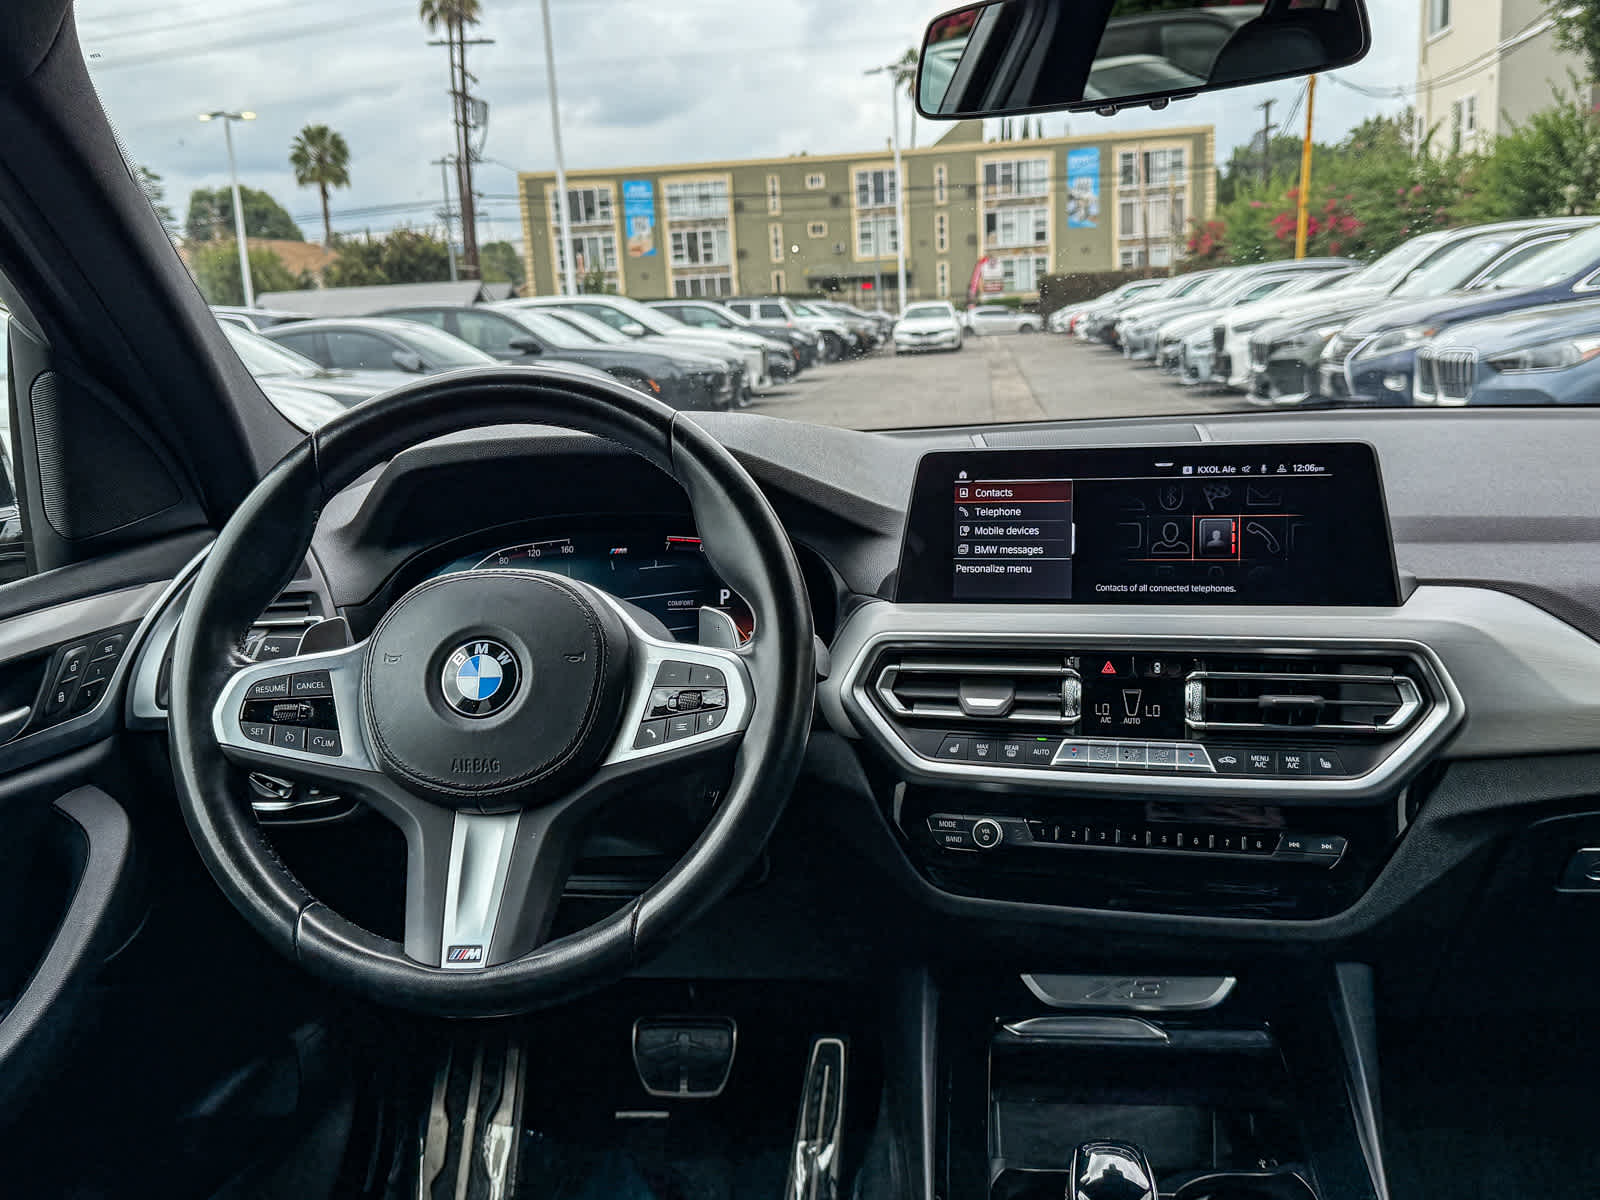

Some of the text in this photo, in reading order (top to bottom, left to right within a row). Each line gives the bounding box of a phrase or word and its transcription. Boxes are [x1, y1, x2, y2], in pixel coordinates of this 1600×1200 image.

[1197, 465, 1221, 474] KXOL
[1292, 464, 1325, 473] 12:06pm
[975, 488, 1014, 498] Contacts
[975, 507, 1022, 518] Telephone
[974, 526, 1040, 536] Mobile devices
[528, 549, 541, 558] 120
[560, 546, 574, 554] 160
[974, 545, 1044, 556] BMW messages
[500, 557, 509, 565] 80
[956, 564, 1032, 574] Personalize menu
[1095, 584, 1237, 594] Contacts of all connected telephones.
[720, 588, 731, 605] P
[452, 642, 512, 666] BMW
[256, 684, 286, 694] RESUME
[296, 682, 326, 690] CANCEL
[1095, 703, 1110, 716] LO
[1145, 704, 1160, 717] LO
[1124, 717, 1141, 725] AUTO
[250, 728, 264, 736] SET
[321, 740, 335, 748] LIM
[451, 758, 501, 774] AIRBAG
[938, 820, 957, 828] MODE
[946, 835, 962, 843] BAND
